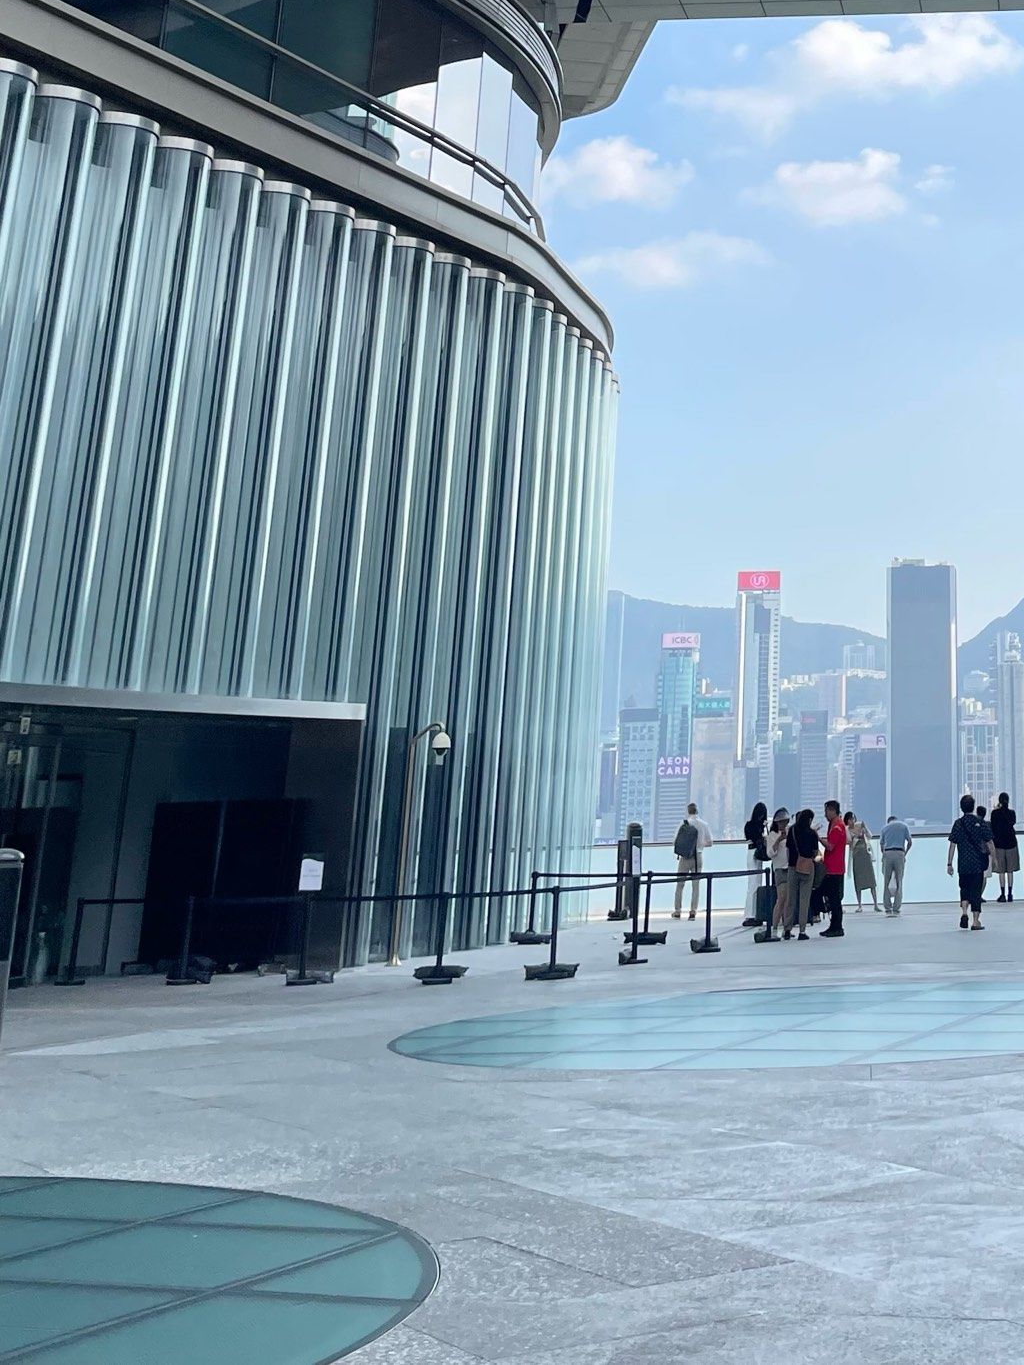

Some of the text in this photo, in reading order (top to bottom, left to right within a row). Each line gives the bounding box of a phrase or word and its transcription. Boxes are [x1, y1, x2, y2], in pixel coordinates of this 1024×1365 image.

[672, 636, 693, 644] ICBC
[658, 756, 690, 765] AEON
[657, 766, 690, 775] CARD
